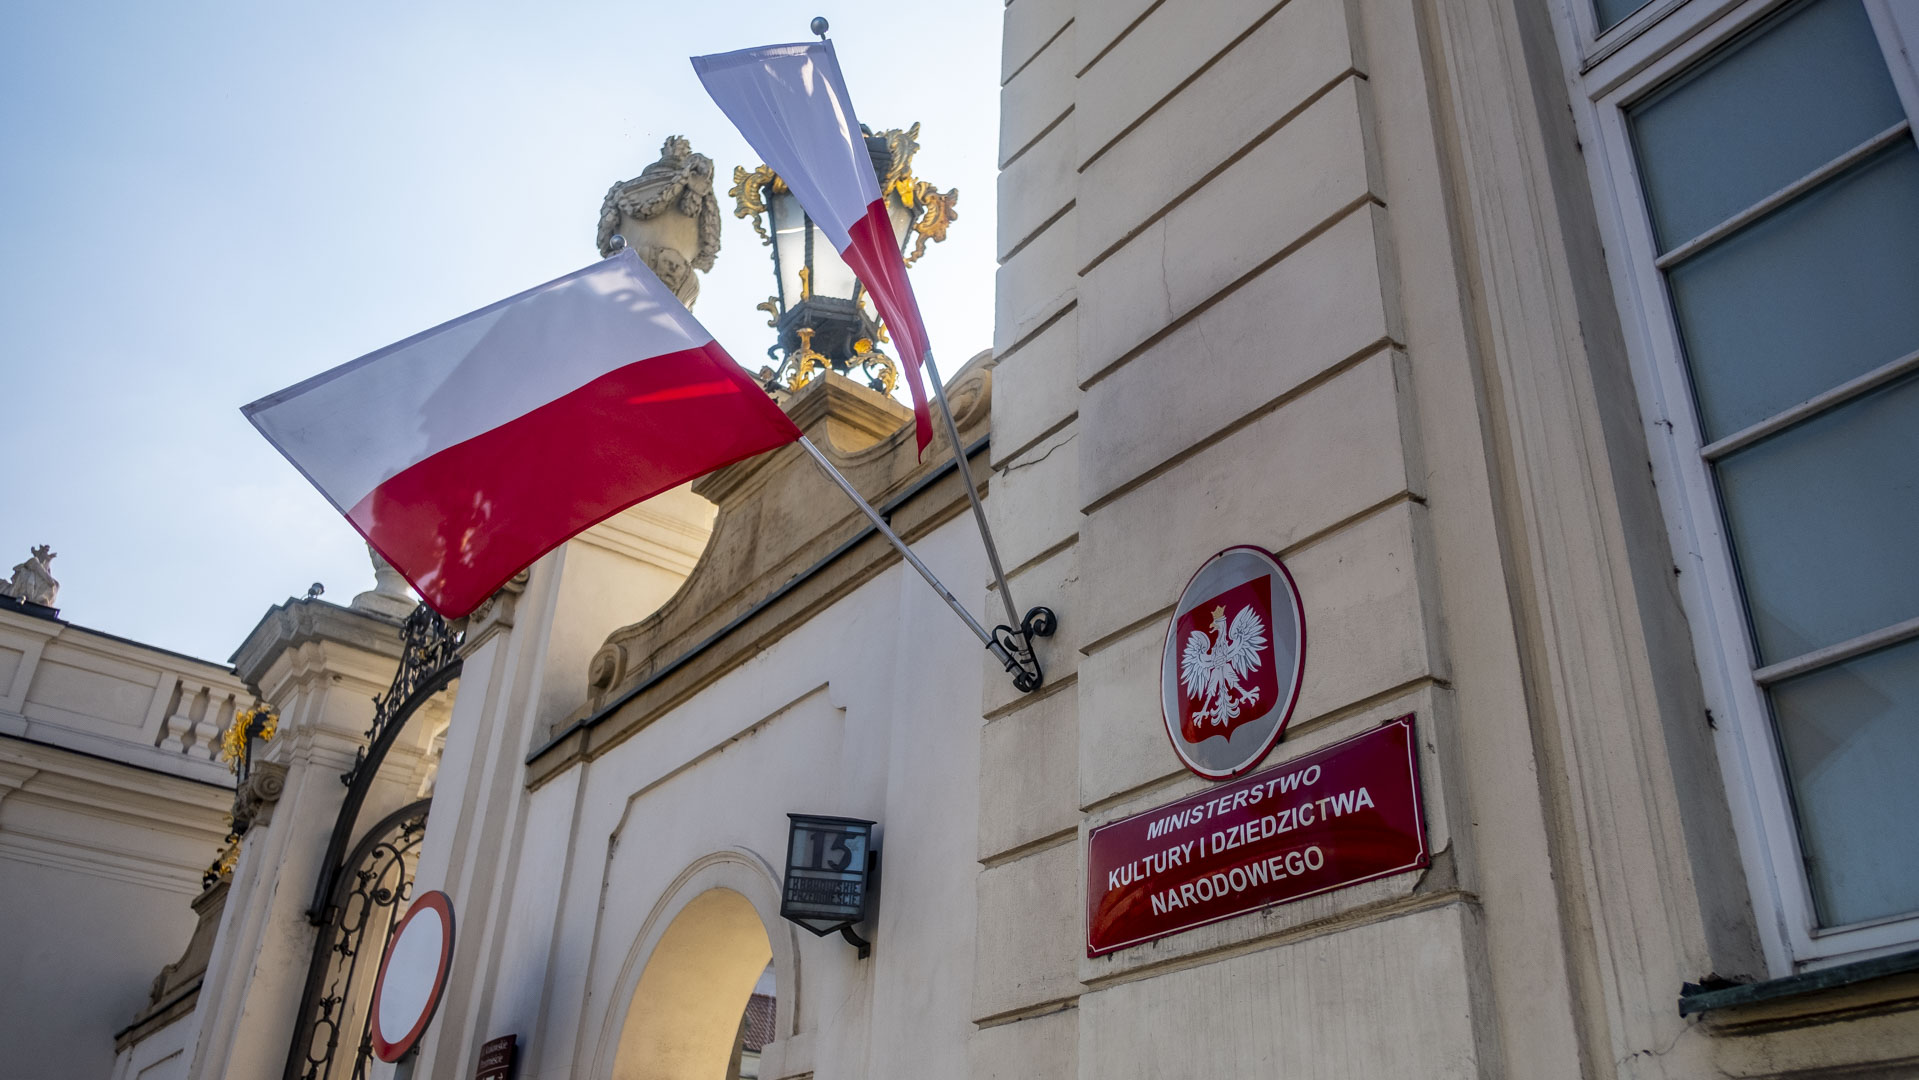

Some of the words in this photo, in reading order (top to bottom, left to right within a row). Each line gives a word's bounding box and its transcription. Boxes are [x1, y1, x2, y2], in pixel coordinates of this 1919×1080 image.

[1147, 764, 1321, 840] MINISTERSTWO
[811, 831, 857, 871] 15
[1108, 840, 1194, 891] KULTURY
[1200, 837, 1206, 858] I
[1211, 787, 1375, 854] DZIEDZICTWA
[1150, 845, 1324, 916] NARODOWEGO
